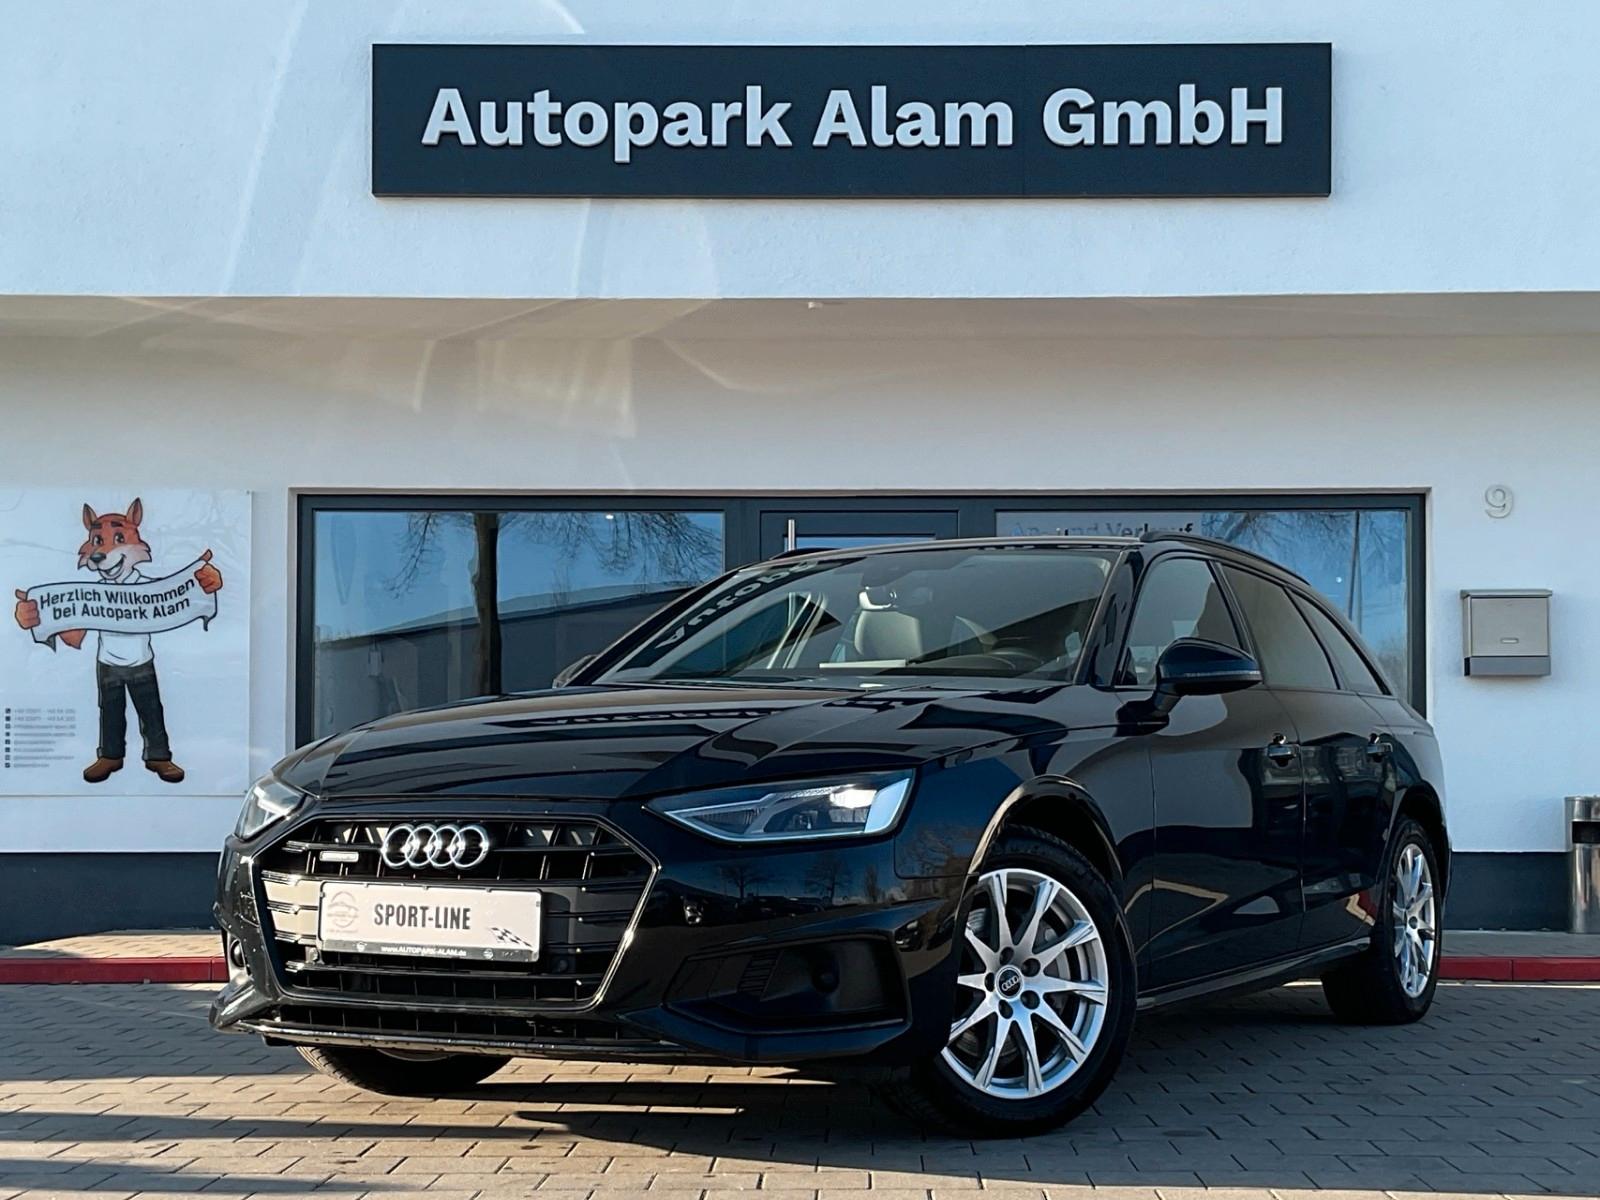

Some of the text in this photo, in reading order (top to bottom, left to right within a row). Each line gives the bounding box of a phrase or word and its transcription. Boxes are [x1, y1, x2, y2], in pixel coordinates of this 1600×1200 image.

[421, 83, 1283, 163] Autopark Alam GmbH
[1484, 483, 1515, 519] 9
[40, 578, 195, 610] Herzlich Willkommen
[53, 597, 190, 621] bei Autopark Alam
[373, 903, 471, 931] SPORT-LINE
